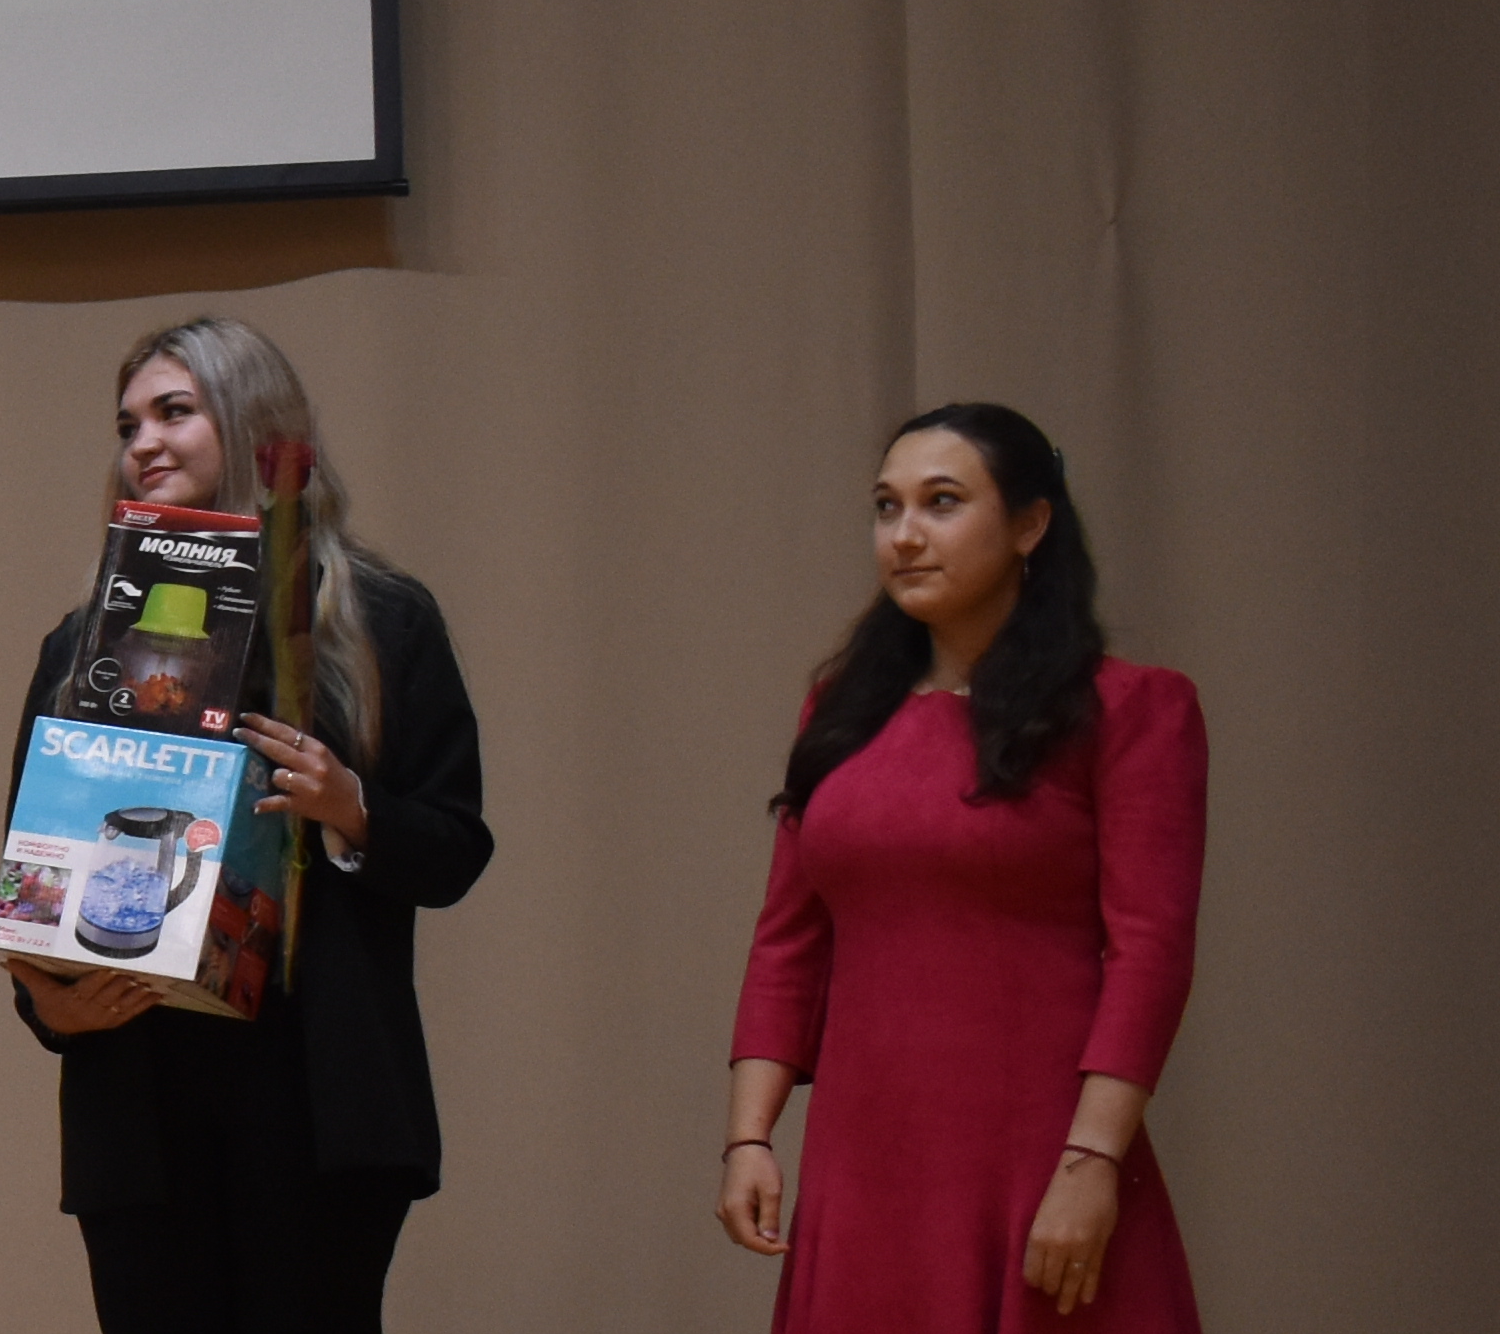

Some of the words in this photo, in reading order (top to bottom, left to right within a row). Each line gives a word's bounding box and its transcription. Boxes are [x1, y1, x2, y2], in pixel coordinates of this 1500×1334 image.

[139, 536, 239, 565] МОЛНИЯ
[119, 692, 130, 705] 2
[203, 709, 226, 724] TV
[40, 727, 226, 779] SCARLETT
